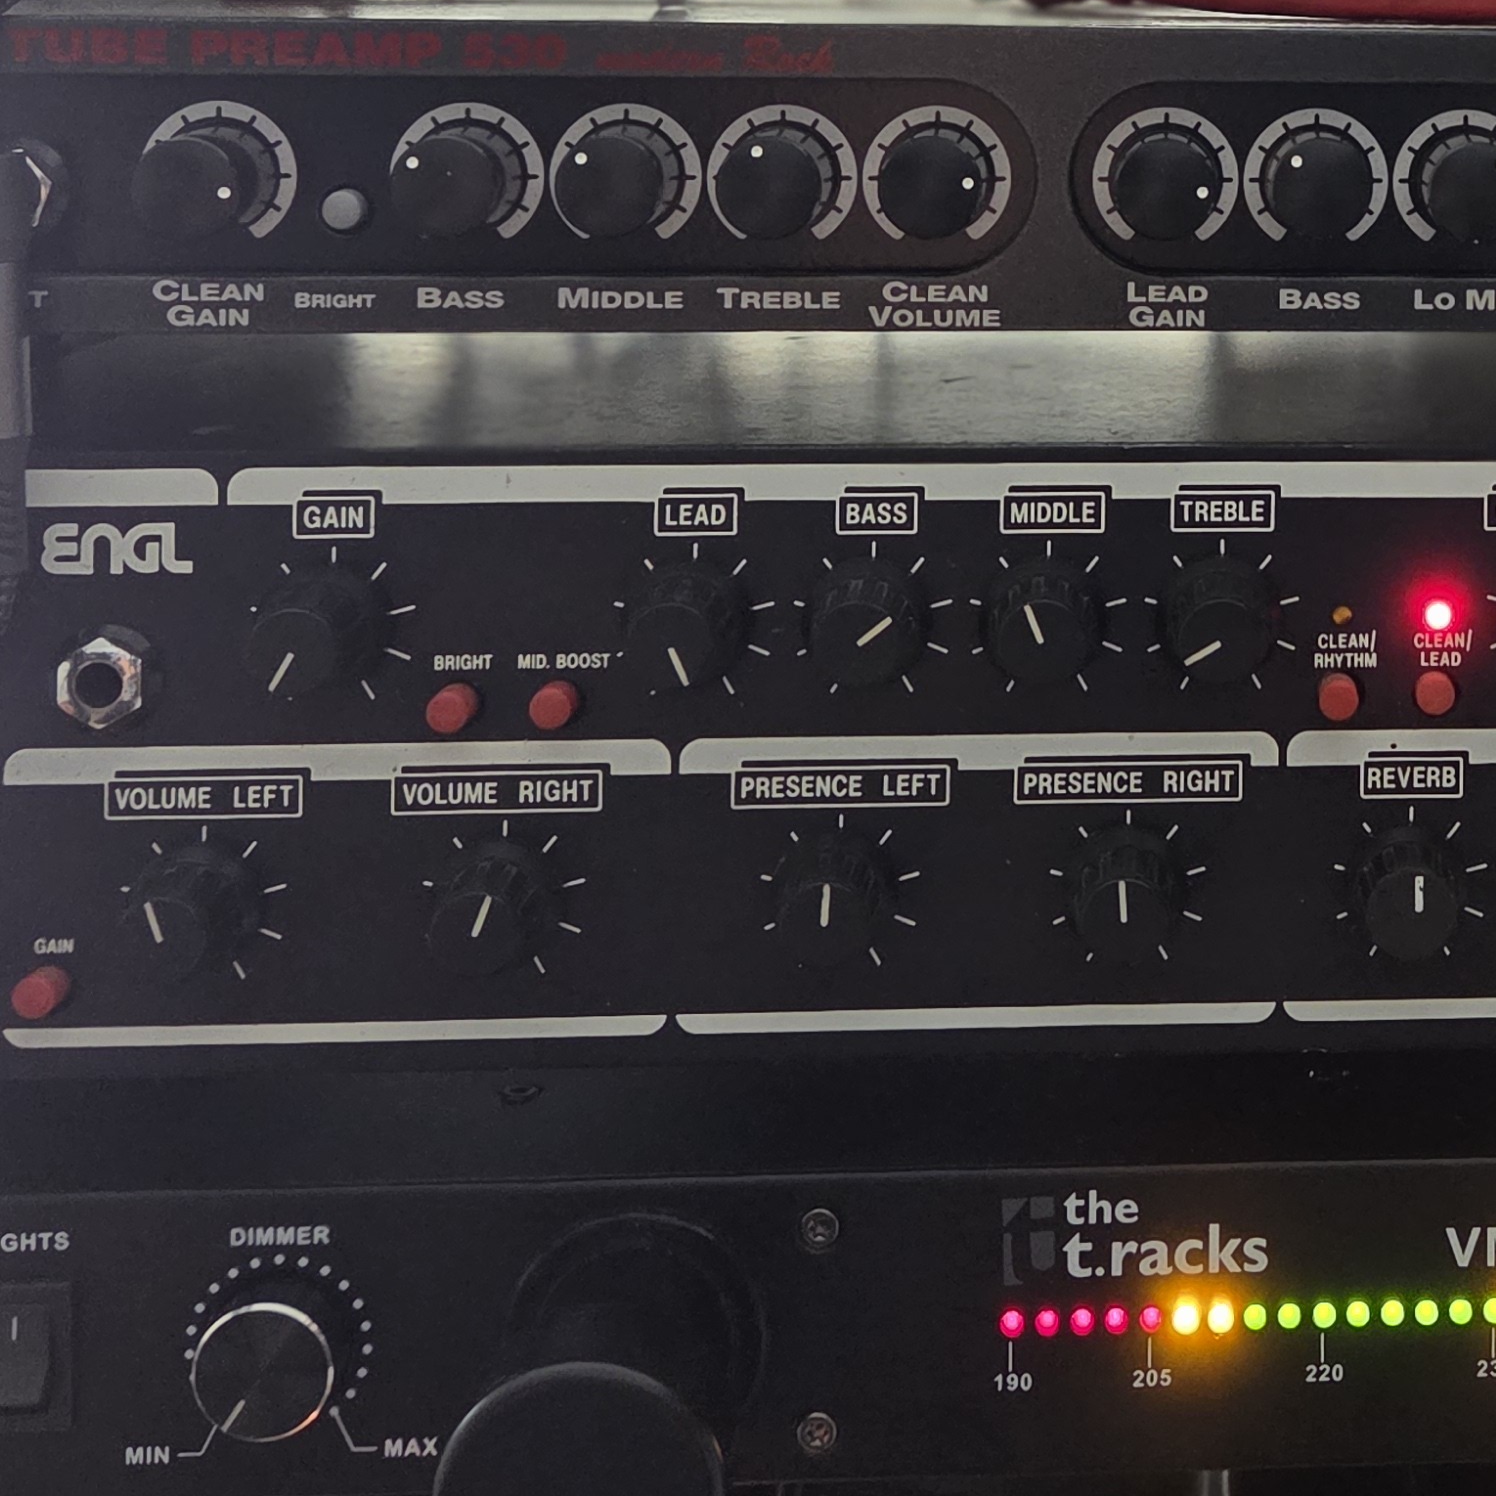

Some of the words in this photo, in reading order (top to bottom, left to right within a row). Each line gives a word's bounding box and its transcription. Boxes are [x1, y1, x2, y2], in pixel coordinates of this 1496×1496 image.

[8, 29, 167, 65] TUBE
[191, 30, 442, 68] PREAMP
[463, 33, 568, 69] 530
[303, 507, 364, 528] GAIN
[665, 505, 726, 525] LEAD
[846, 504, 907, 524] BASS
[1010, 502, 1095, 523] MIDDLE
[1180, 500, 1265, 521] TREBLE
[40, 522, 193, 575] ENGL
[1317, 630, 1376, 650] CLEAN/
[1413, 630, 1472, 650] CLEAN/
[433, 654, 493, 670] BRIGHT
[517, 654, 549, 669] MID.
[556, 653, 609, 669] BOOST
[1314, 653, 1377, 668] RHYTHM
[1420, 651, 1461, 667] LEAD
[740, 775, 862, 798] PRESENCE
[883, 774, 940, 796] LEFT
[1023, 772, 1142, 795] PRESENCE
[1163, 770, 1234, 792] RIGHT
[1367, 767, 1456, 789] REVERB
[115, 787, 211, 810] VOLUME
[234, 785, 293, 808] LEFT
[402, 783, 497, 805] VOLUME
[519, 780, 593, 803] RIGHT
[34, 938, 73, 954] GAIN
[1064, 1189, 1139, 1225] the
[1, 1231, 70, 1252] GHTS
[230, 1226, 331, 1247] DIMMER
[1062, 1223, 1269, 1278] t.racks
[993, 1372, 1033, 1391] 190
[1132, 1369, 1172, 1387] 205
[1305, 1363, 1344, 1383] 220
[125, 1447, 169, 1465] MIN
[384, 1438, 438, 1457] MAX
